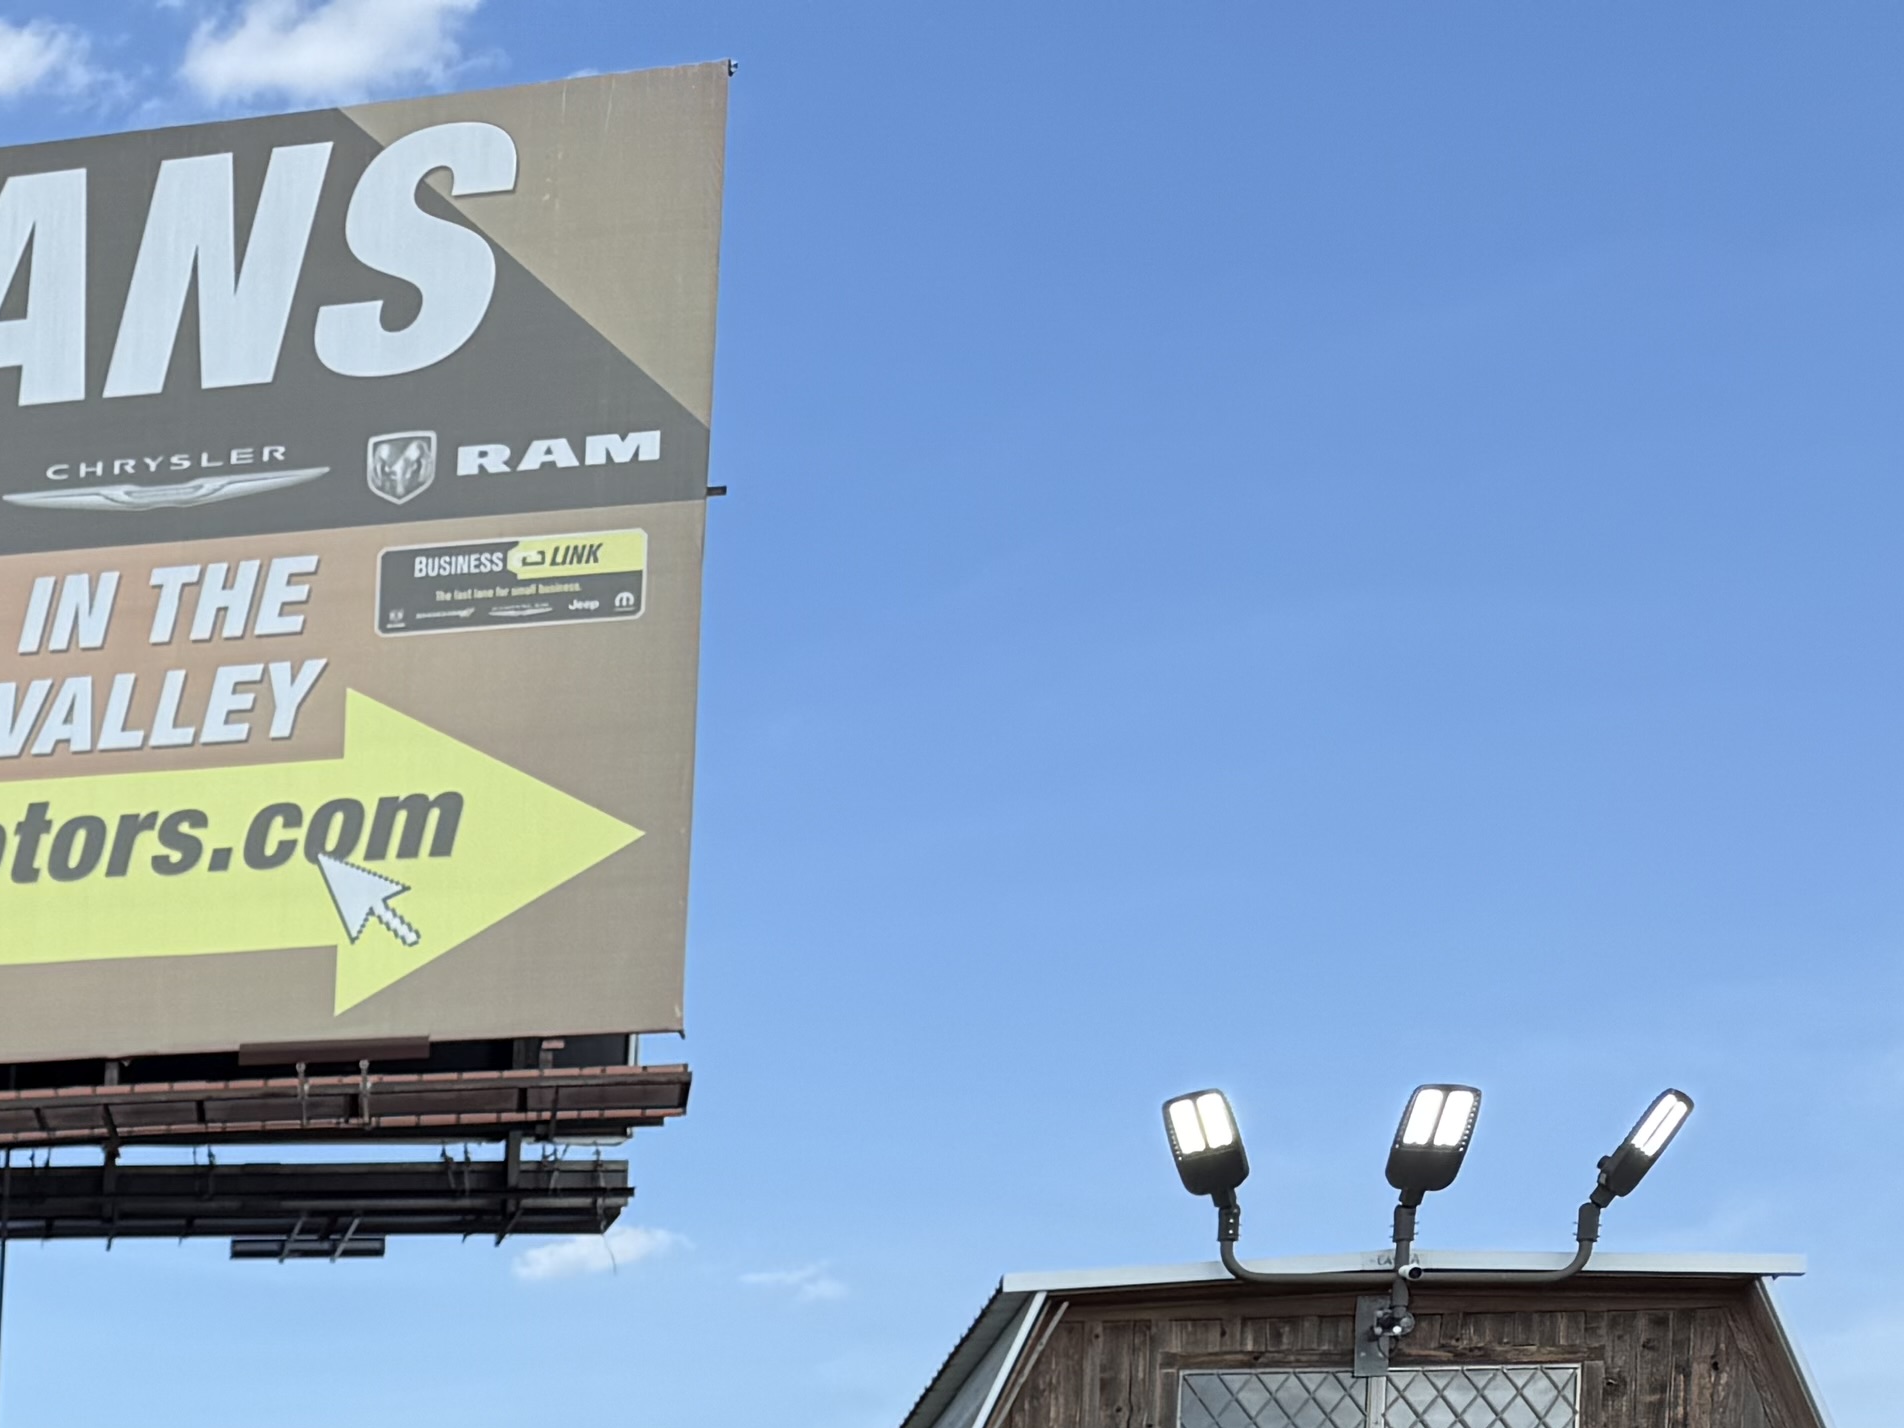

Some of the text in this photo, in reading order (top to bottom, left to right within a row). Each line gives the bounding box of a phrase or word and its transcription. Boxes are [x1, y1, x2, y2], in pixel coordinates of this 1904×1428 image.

[45, 445, 286, 481] CHRYSLER
[456, 429, 662, 477] RAM
[413, 542, 604, 578] BUSINESS LINK
[17, 570, 120, 655] IN
[147, 554, 320, 645] THE
[568, 599, 600, 611] Jeep
